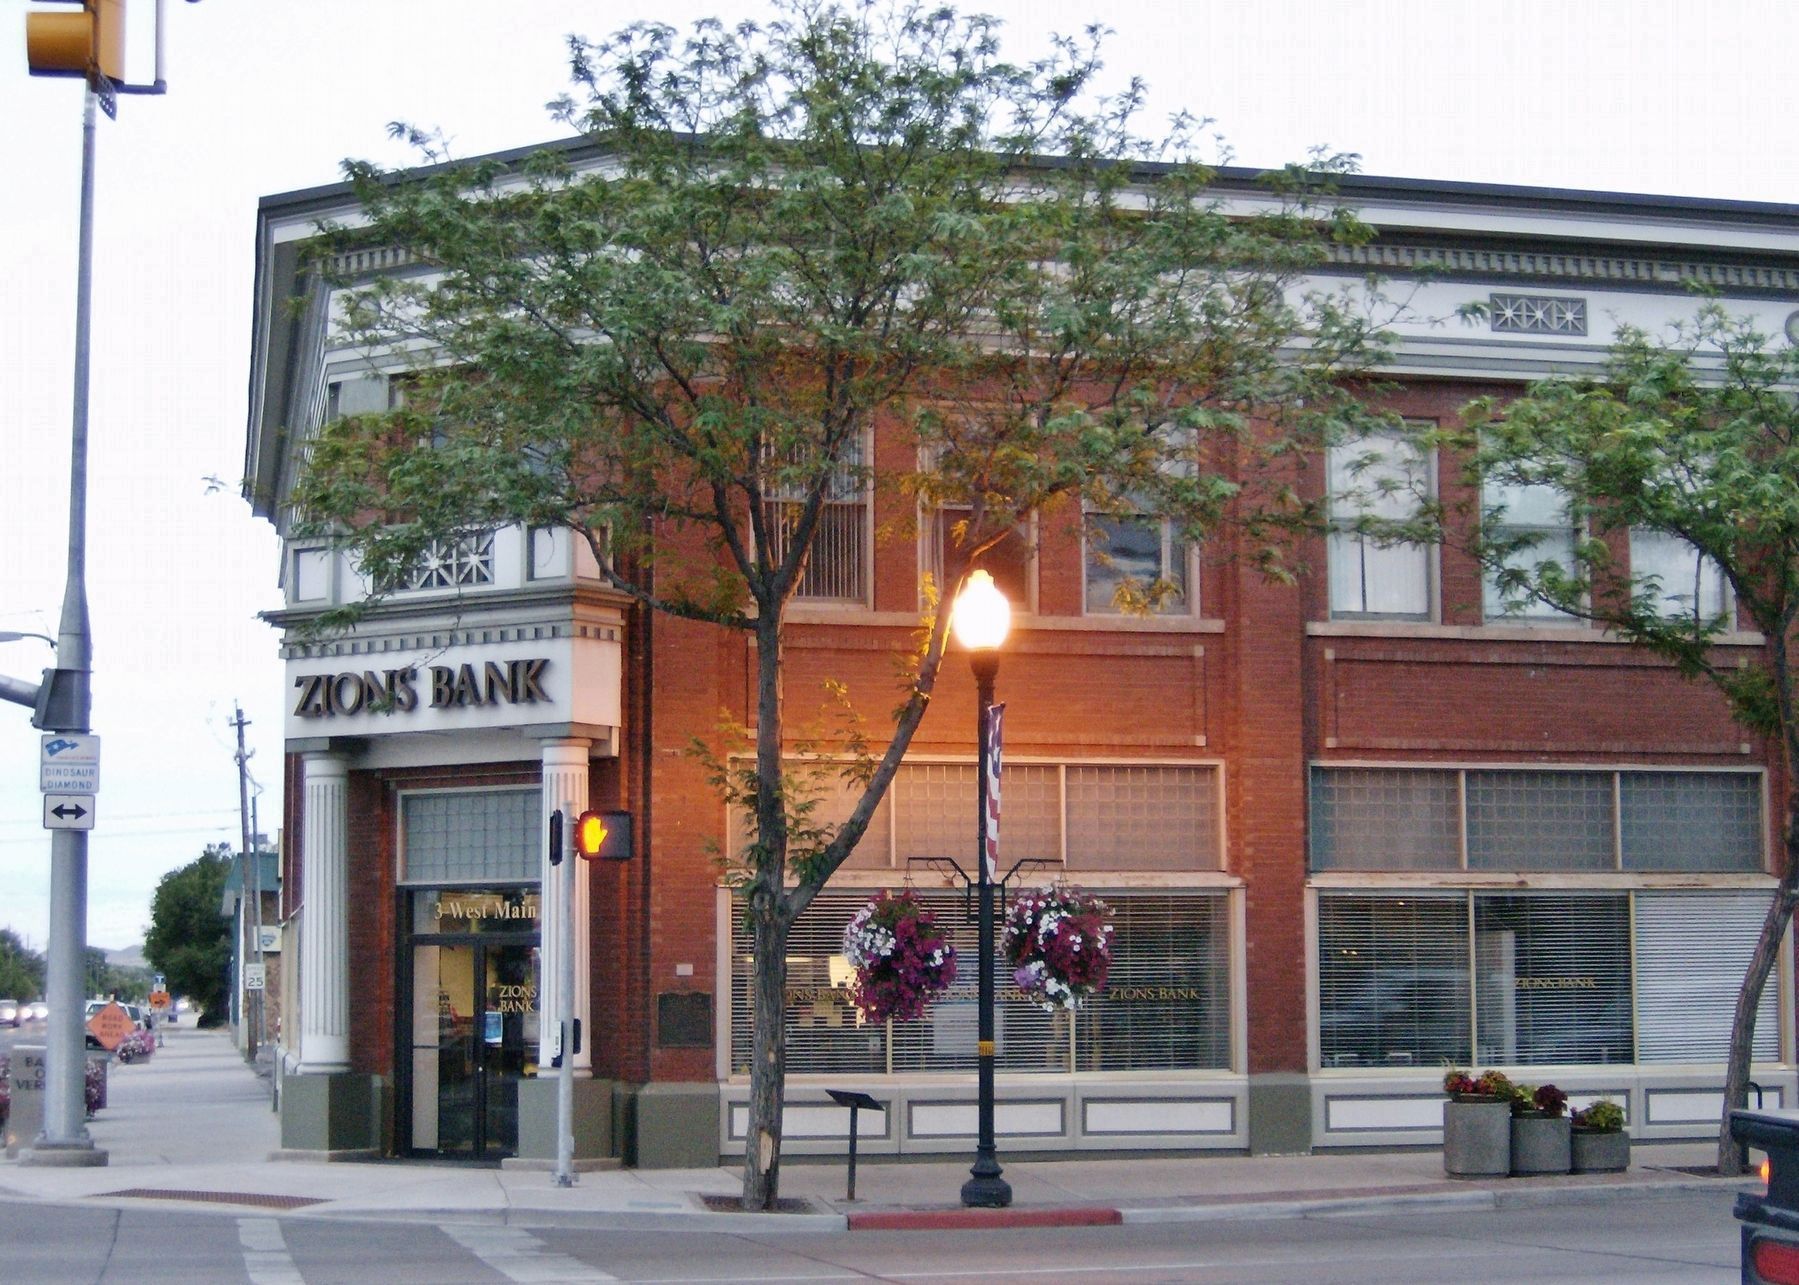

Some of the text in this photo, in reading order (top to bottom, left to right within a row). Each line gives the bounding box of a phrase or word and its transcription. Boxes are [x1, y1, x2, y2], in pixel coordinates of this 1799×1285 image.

[294, 658, 553, 718] ZIONS BANK
[45, 767, 95, 777] DINOSAUR
[47, 781, 93, 790] DIAMOND
[434, 901, 536, 920] 3 West Main
[247, 976, 264, 987] 25
[499, 985, 537, 998] ZIONS
[1110, 987, 1199, 999] ZIONS BANK
[500, 1000, 534, 1013] BANK
